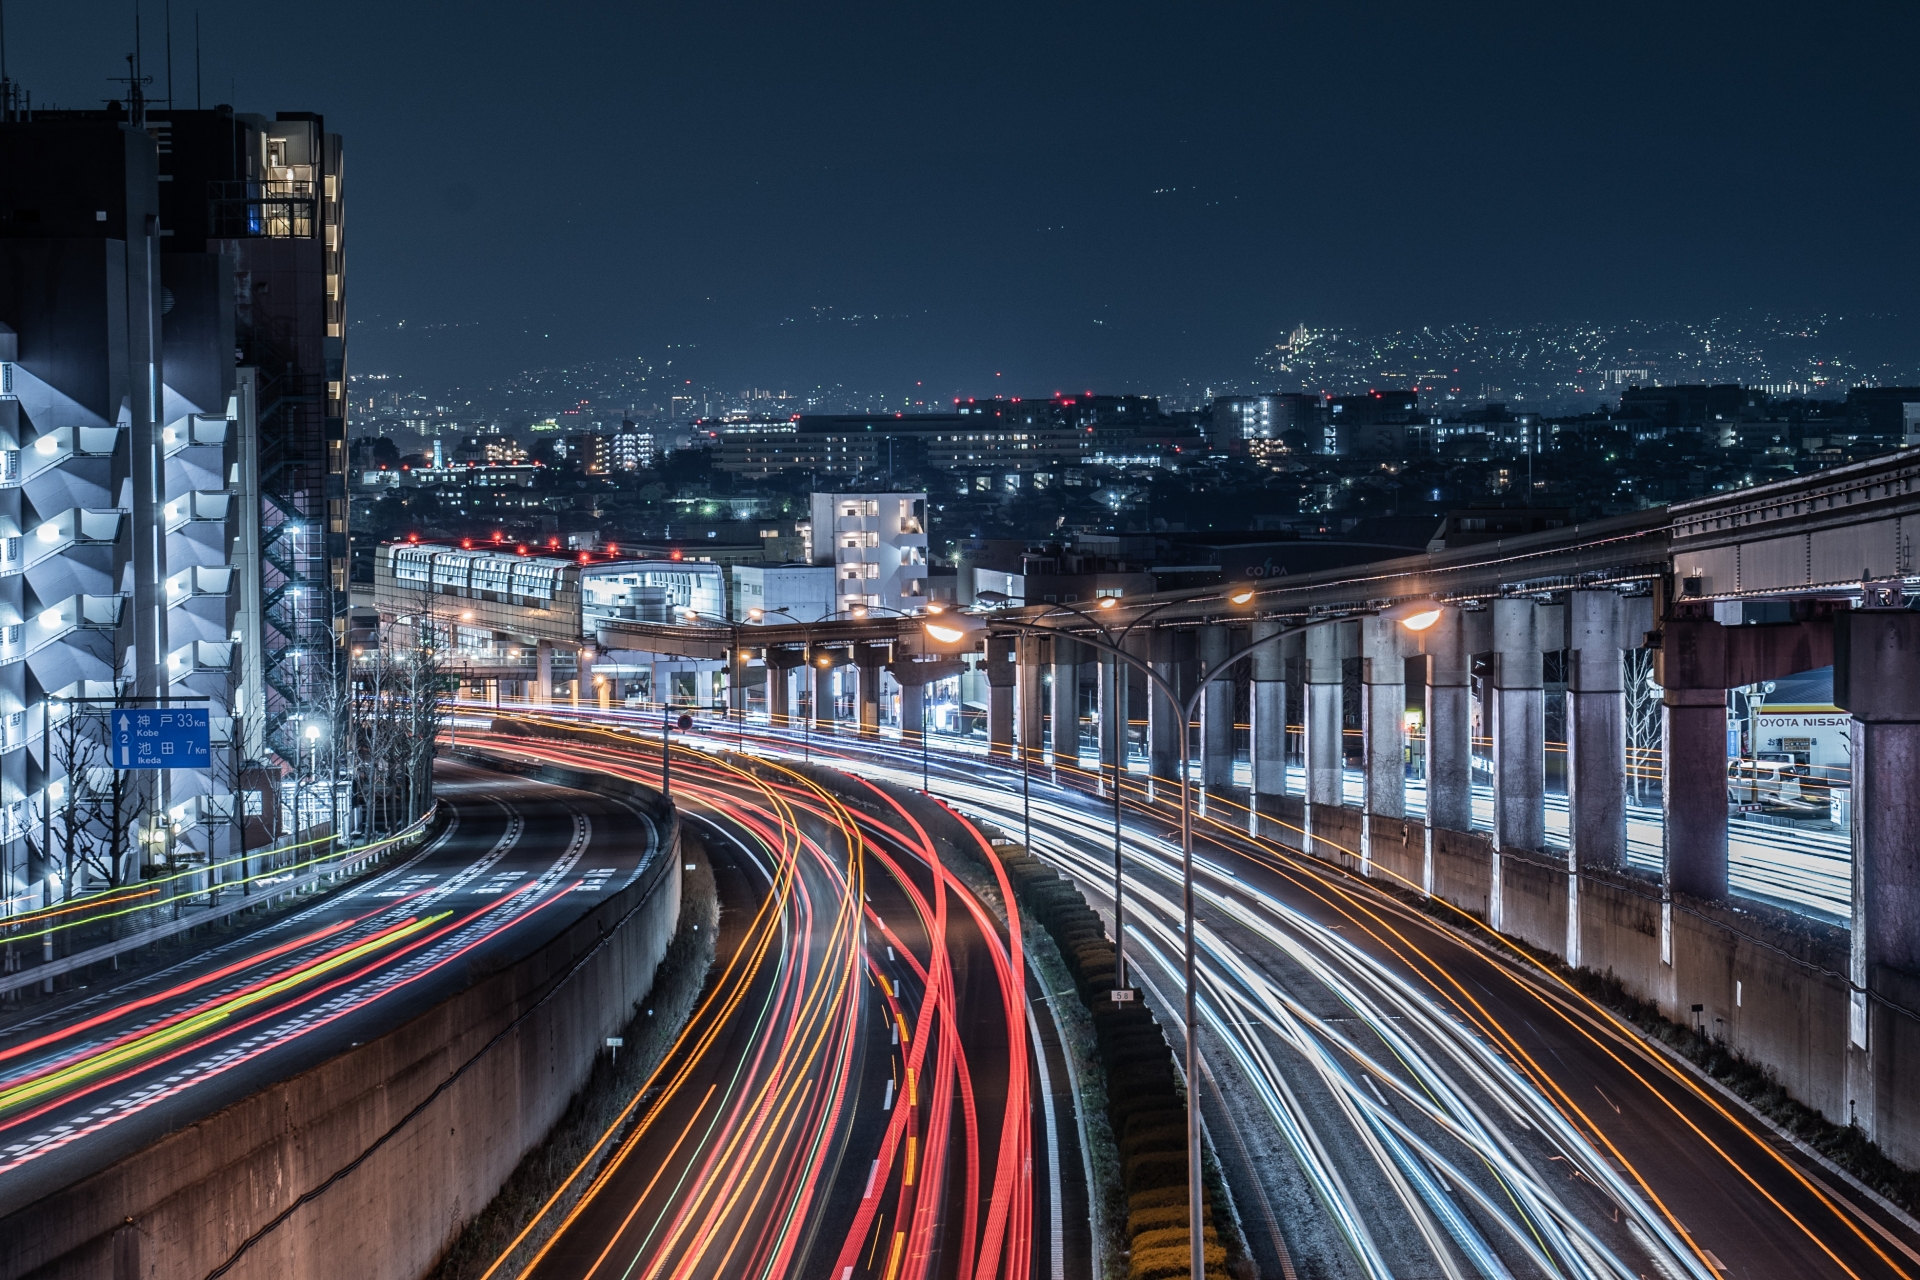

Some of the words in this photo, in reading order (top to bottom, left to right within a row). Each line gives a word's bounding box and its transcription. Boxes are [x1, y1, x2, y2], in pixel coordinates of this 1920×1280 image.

[136, 714, 173, 728] 神戸
[1803, 718, 1851, 727] NISSAN
[136, 729, 159, 737] Kobe
[121, 734, 129, 744] 2
[138, 742, 174, 755] 池田
[137, 756, 162, 764] Ikeda
